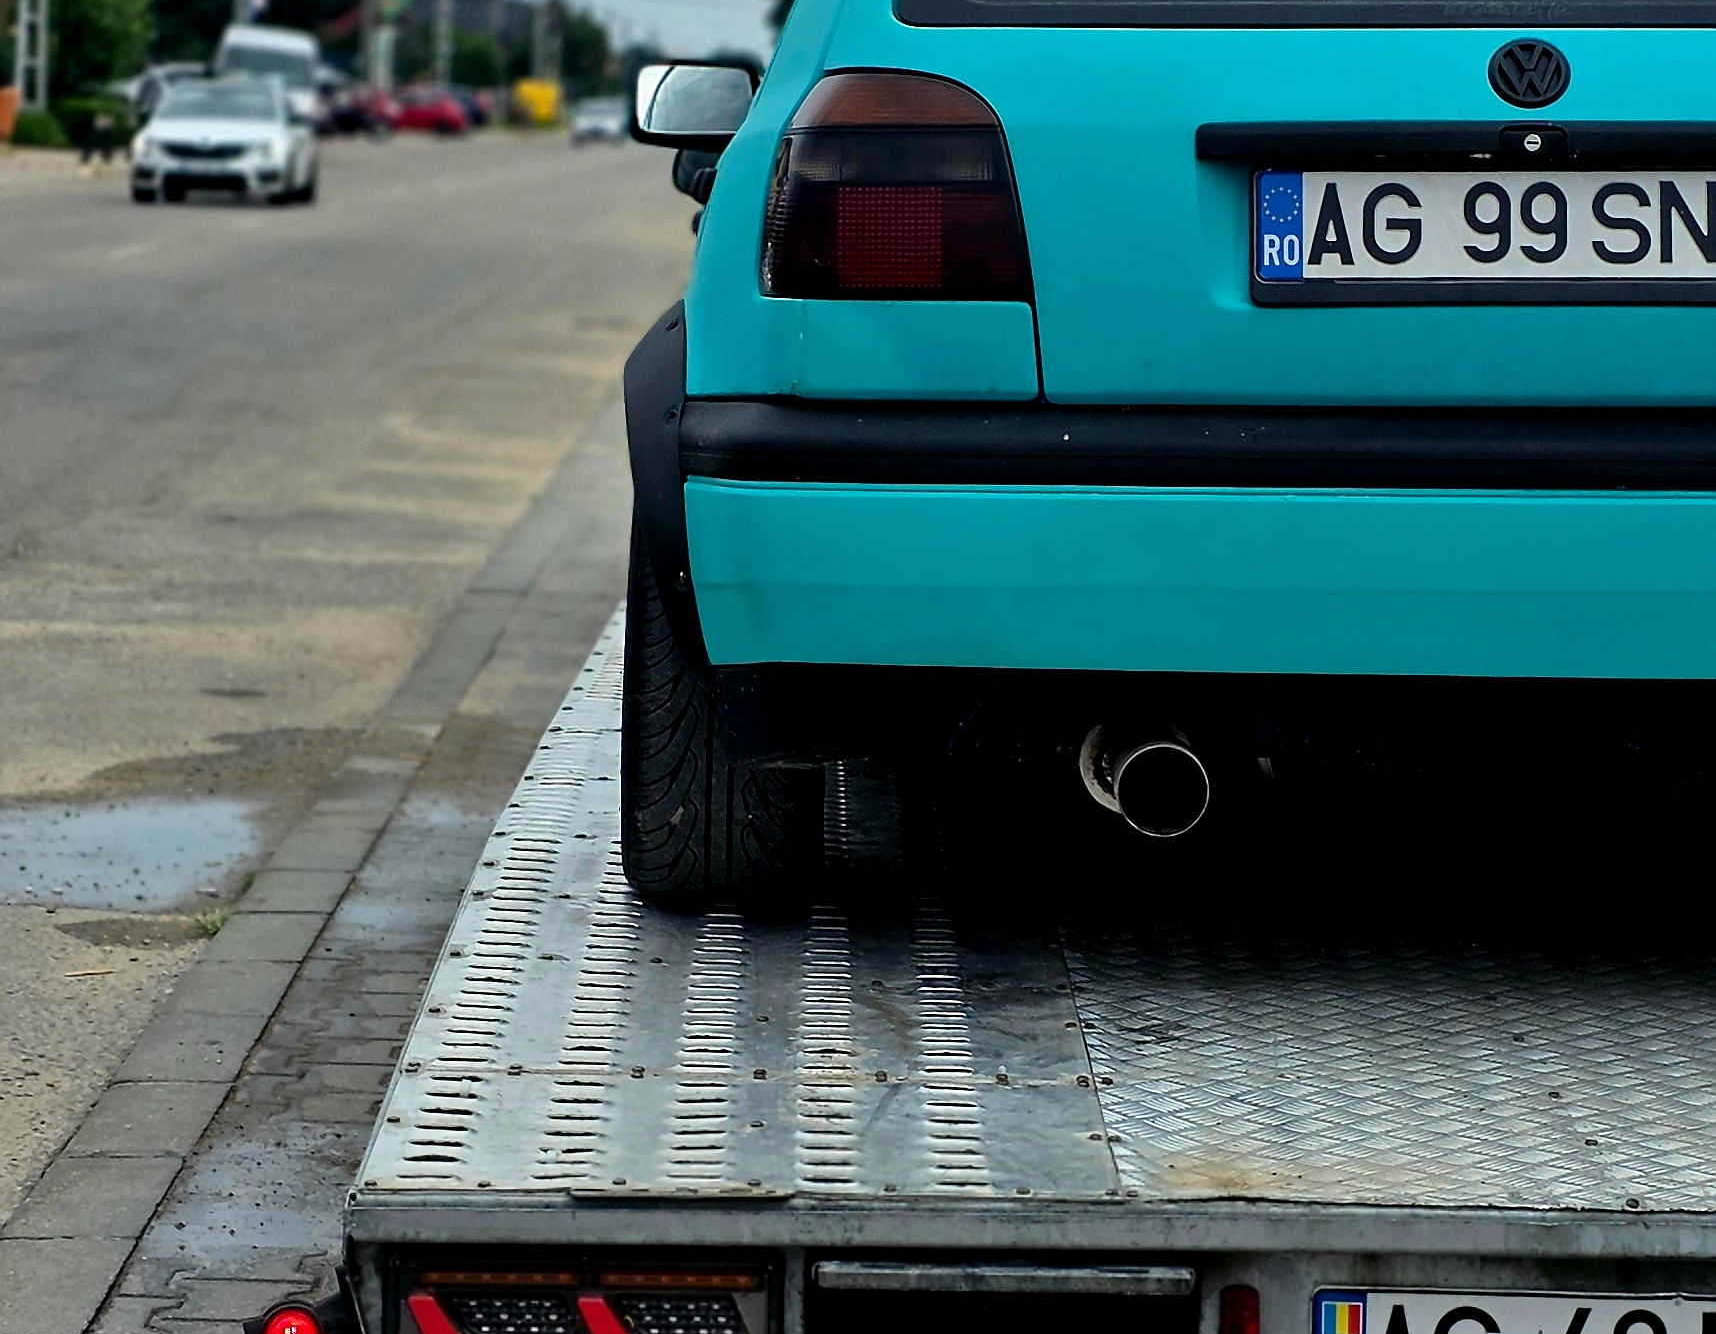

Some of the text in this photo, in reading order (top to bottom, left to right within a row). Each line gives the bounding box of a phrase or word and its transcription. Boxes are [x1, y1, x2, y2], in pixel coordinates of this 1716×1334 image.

[1495, 41, 1564, 100] VW
[1263, 234, 1300, 267] RO
[1307, 180, 1716, 265] AG 99 SN
